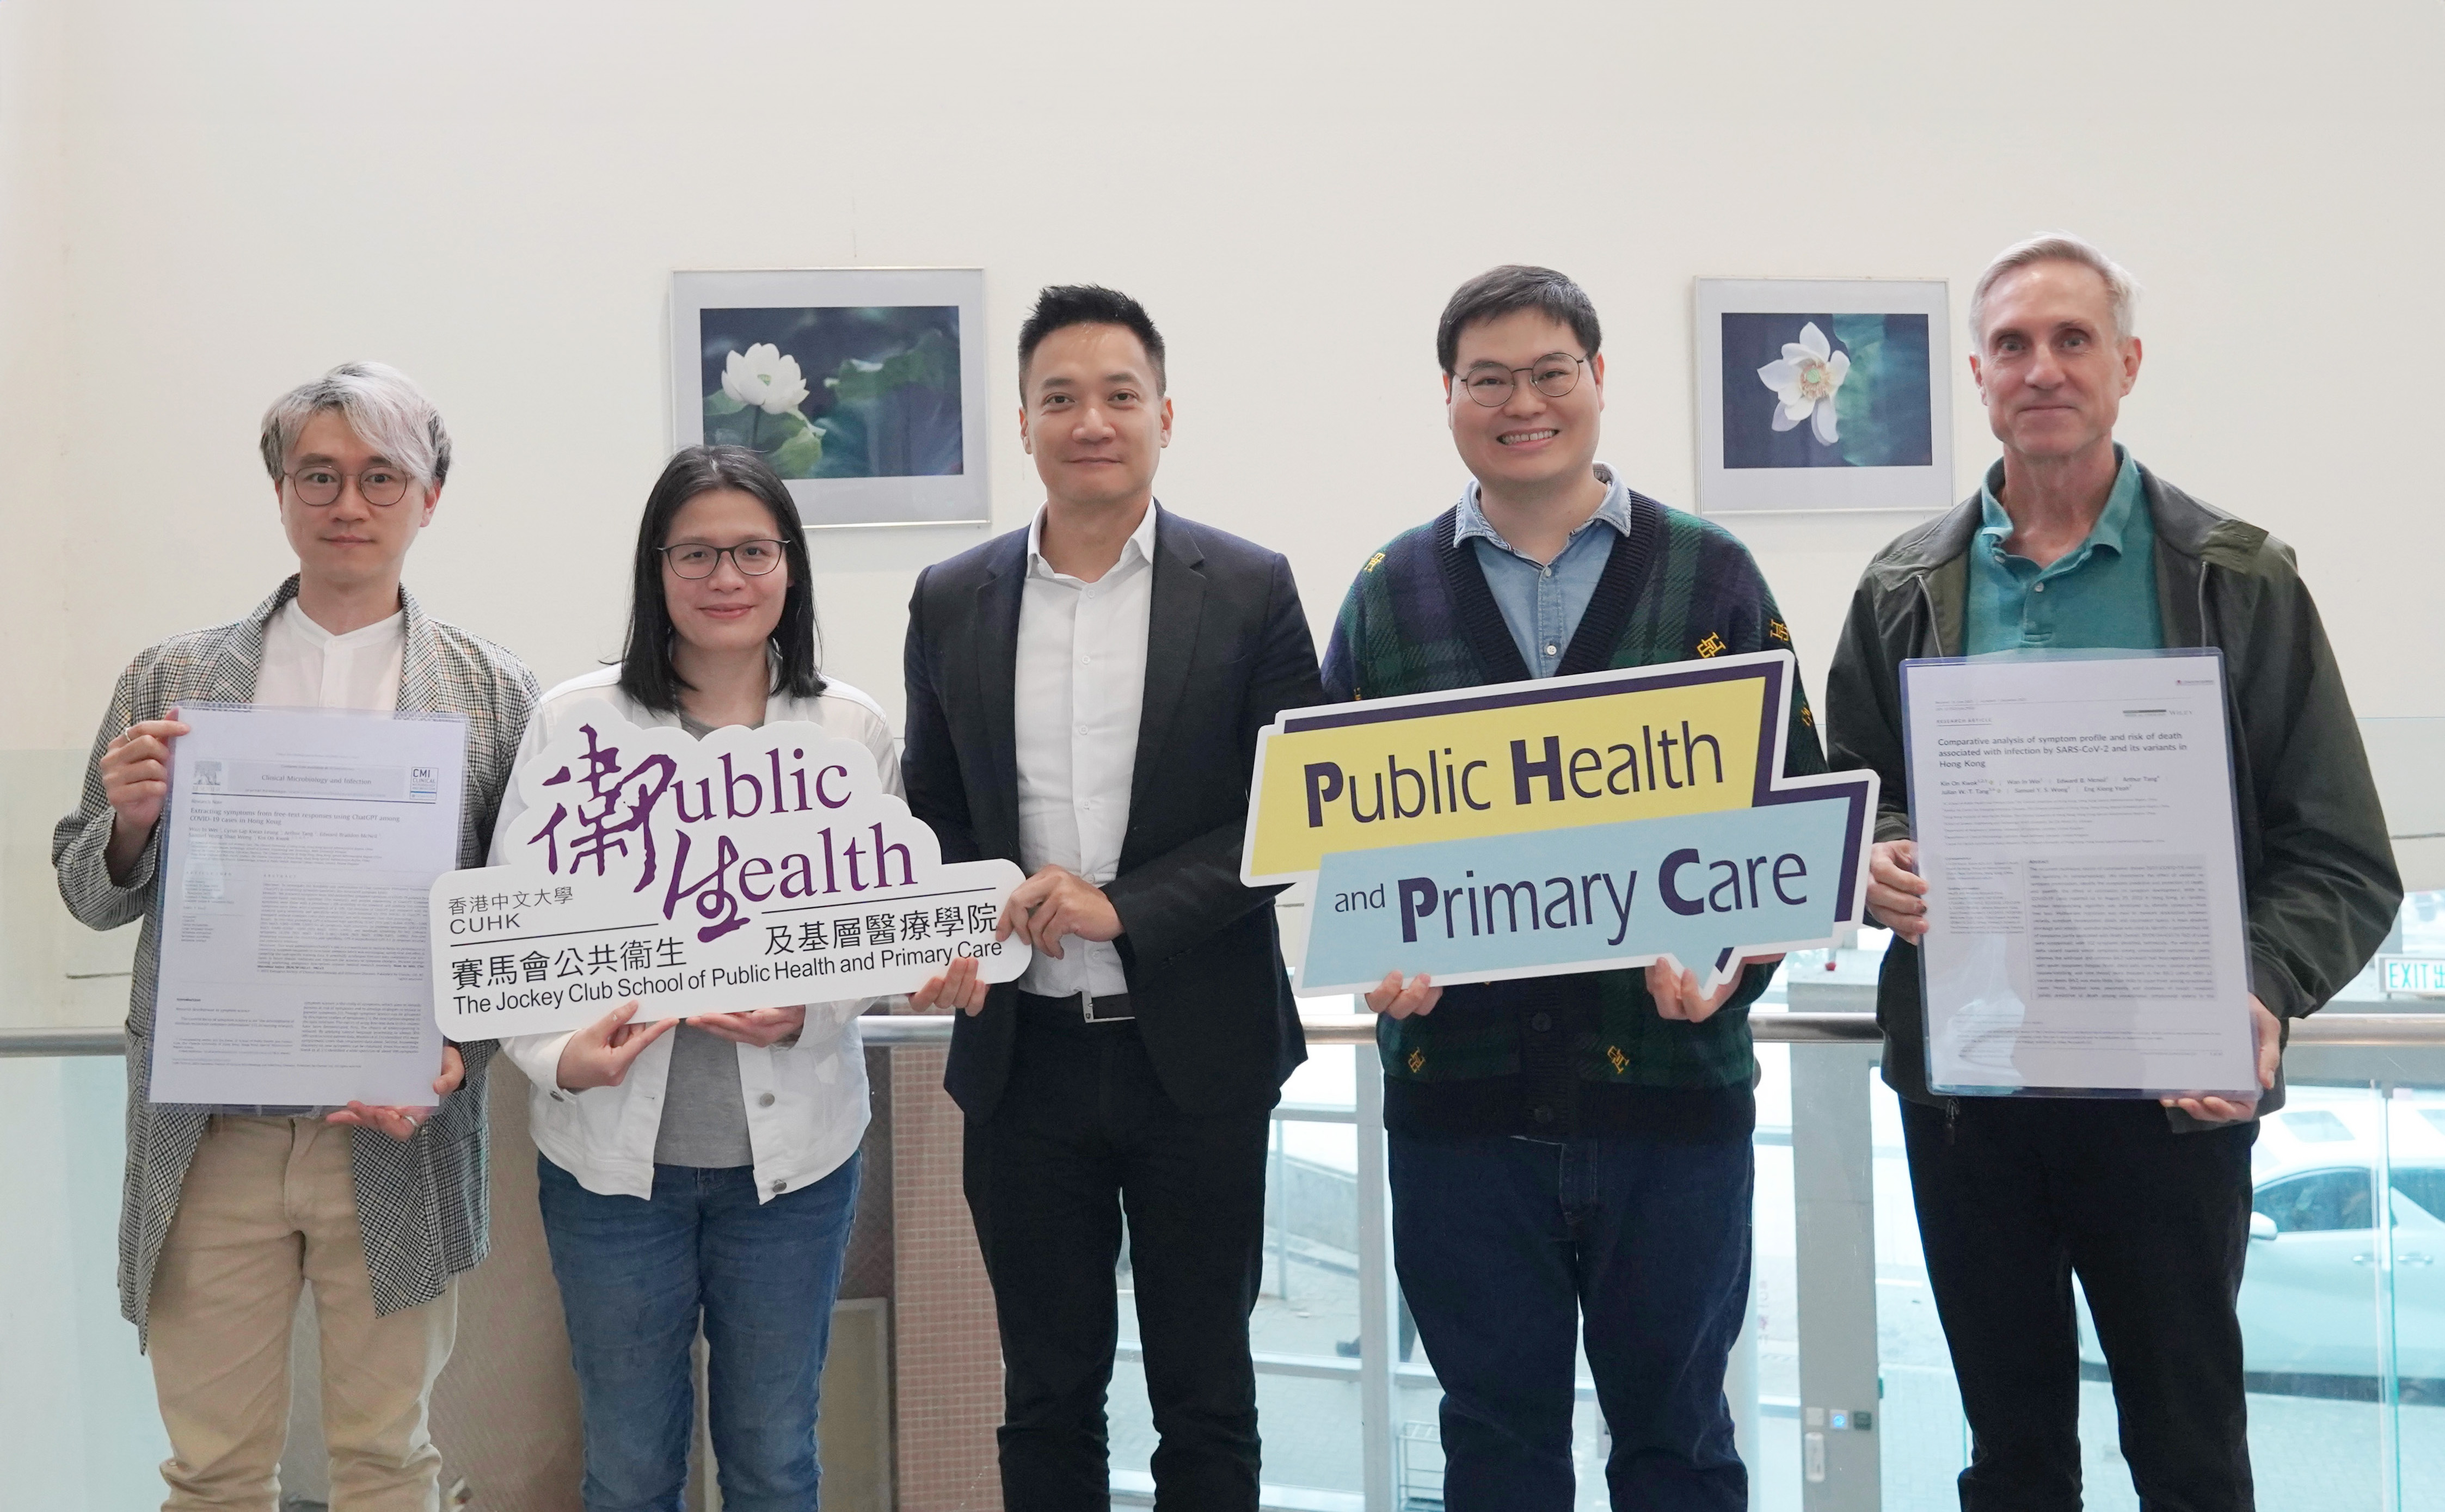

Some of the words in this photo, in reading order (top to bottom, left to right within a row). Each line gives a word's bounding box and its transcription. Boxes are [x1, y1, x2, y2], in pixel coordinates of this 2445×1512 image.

[1938, 739, 1989, 747] Comparative
[1992, 737, 2024, 746] analysis
[2080, 734, 2106, 742] profile
[2056, 745, 2109, 753] SARS-CoV-2
[413, 769, 430, 778] CMI
[1304, 748, 1491, 827] Public
[1510, 721, 1723, 805] Health
[1964, 760, 1986, 768] Kong
[287, 776, 328, 784] Microbiology
[191, 808, 222, 816] Extracting
[448, 886, 573, 915] 香港中文大學
[1335, 883, 1385, 913] and
[1398, 870, 1637, 946] Primary
[1658, 849, 1807, 915] Care
[450, 913, 520, 934] CUHK
[765, 903, 997, 955] 及基層醫療學院
[453, 994, 491, 1015] The
[496, 988, 563, 1011] Jockey
[569, 981, 613, 1003] Club
[618, 973, 683, 997] School
[688, 970, 706, 989] of
[712, 964, 770, 987] Public
[775, 957, 835, 980] Health
[840, 952, 874, 973] and
[881, 947, 953, 967] Primary
[957, 941, 1002, 958] Care
[2389, 963, 2429, 989] EXIT
